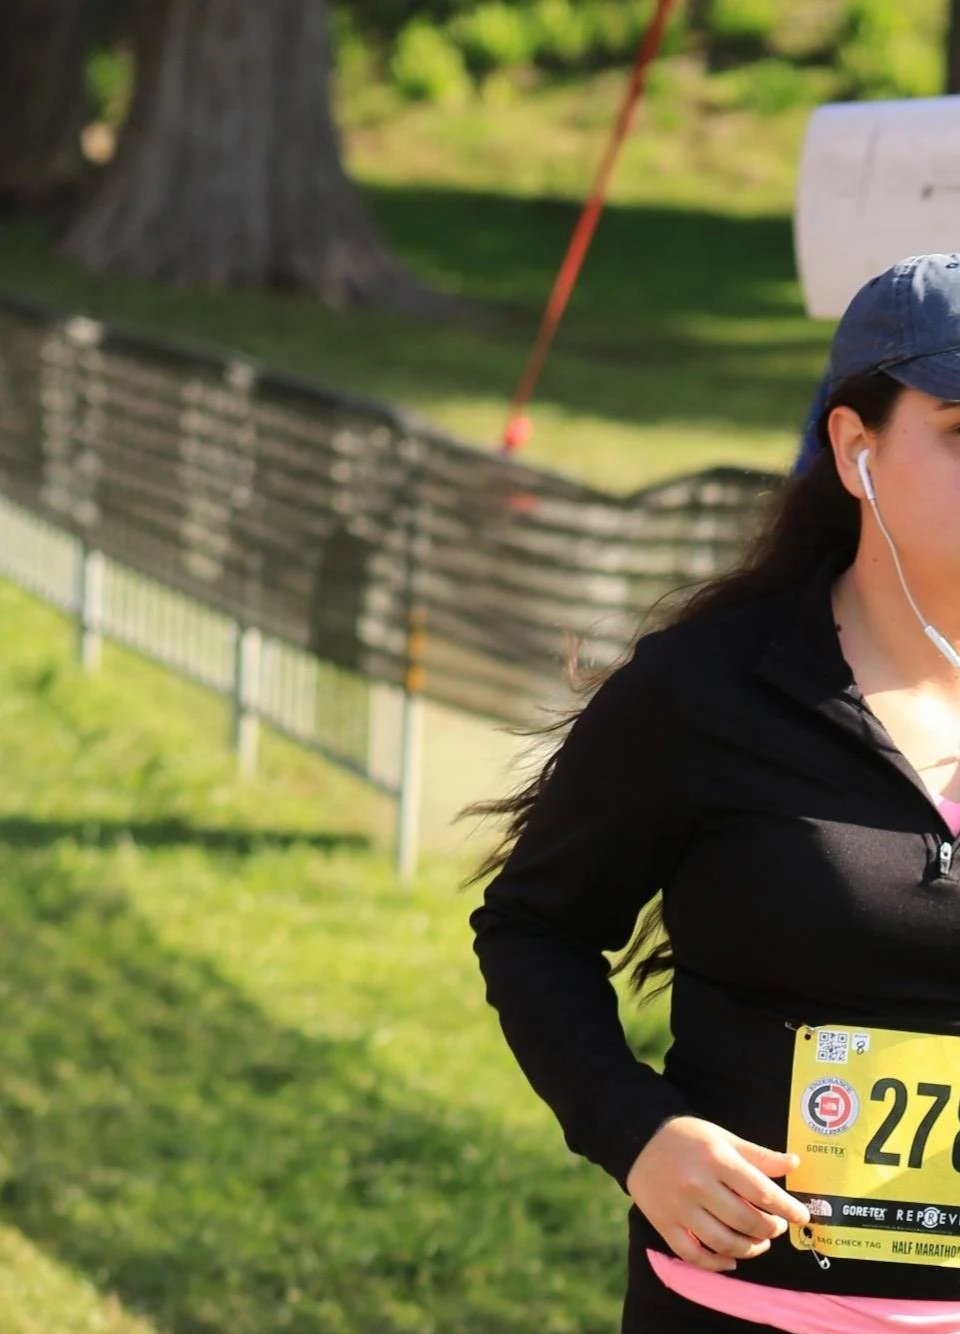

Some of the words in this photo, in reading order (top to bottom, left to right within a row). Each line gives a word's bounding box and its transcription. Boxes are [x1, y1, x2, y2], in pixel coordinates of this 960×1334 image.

[835, 1239, 862, 1247] CHECK
[865, 1241, 881, 1249] TAG
[892, 1240, 913, 1254] HALF
